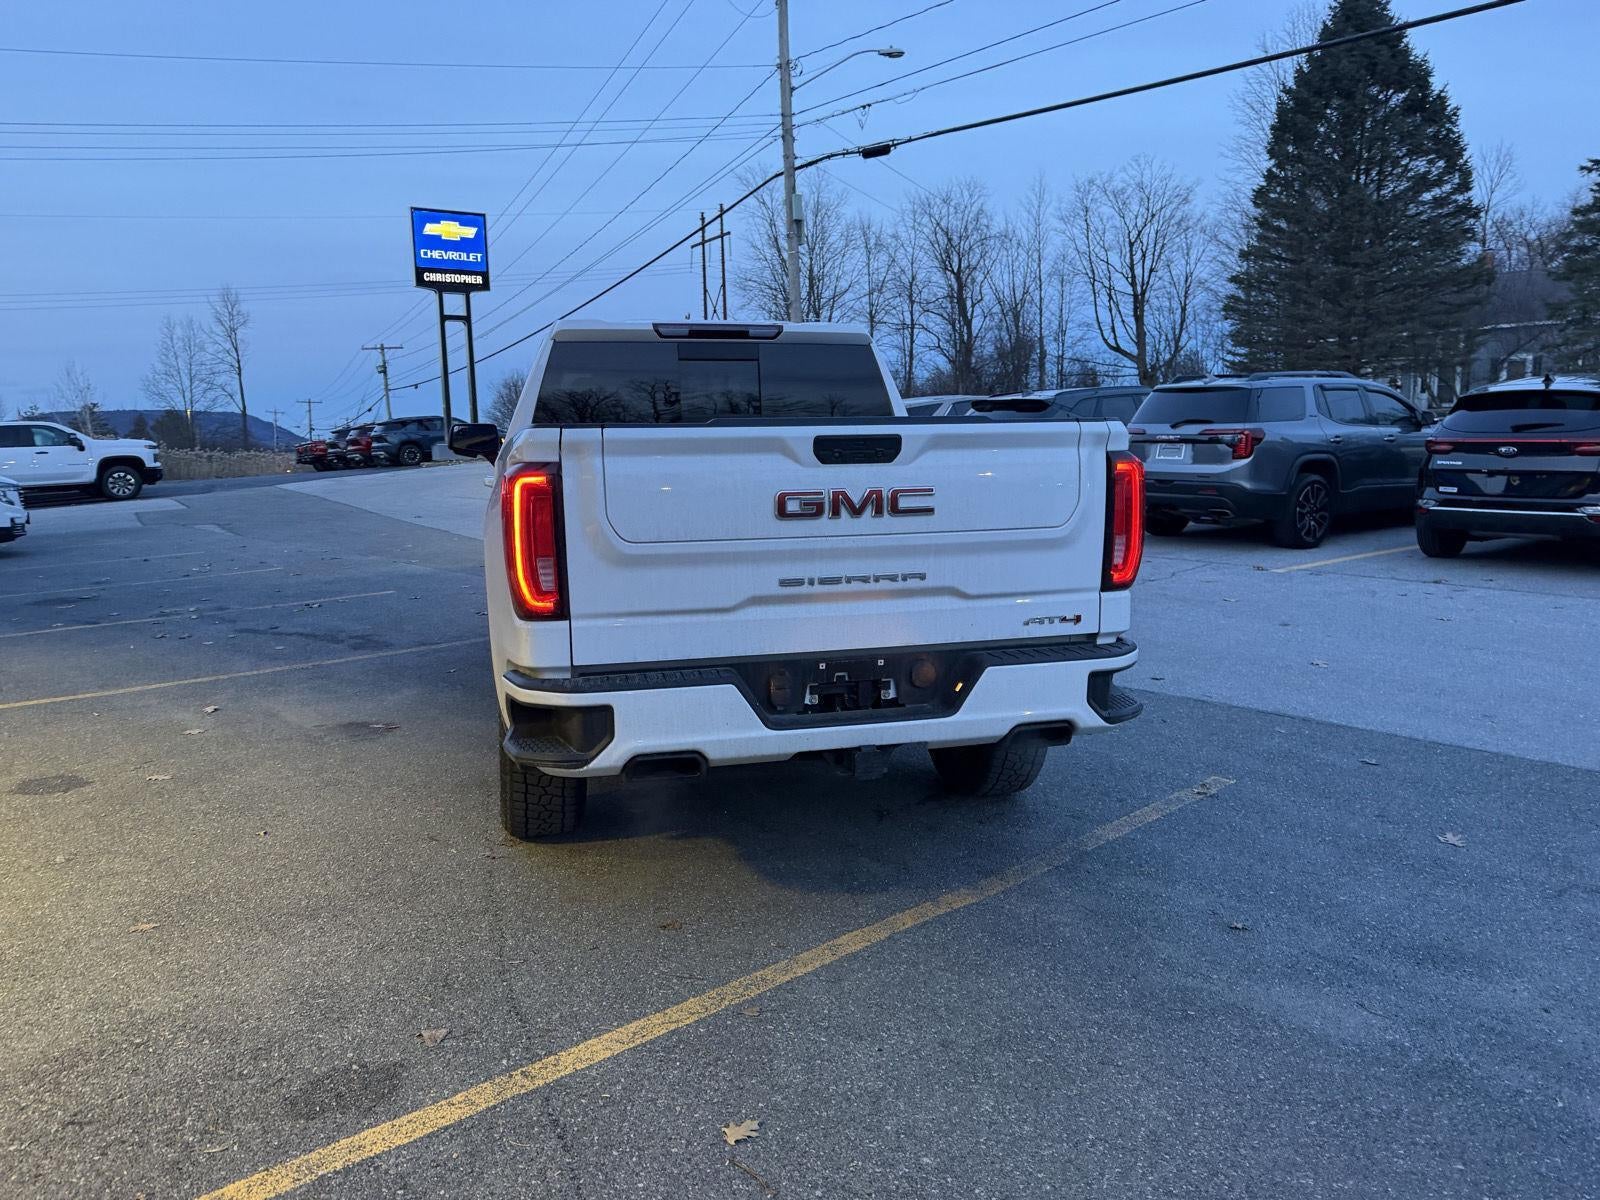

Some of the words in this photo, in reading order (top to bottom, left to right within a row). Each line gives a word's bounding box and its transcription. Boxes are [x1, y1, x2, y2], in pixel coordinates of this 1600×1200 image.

[420, 249, 482, 262] CHEVROLET
[423, 272, 483, 284] CHRISTOPHER
[775, 486, 935, 520] GMC
[778, 572, 926, 587] SIERRA
[1023, 614, 1082, 626] AT4
